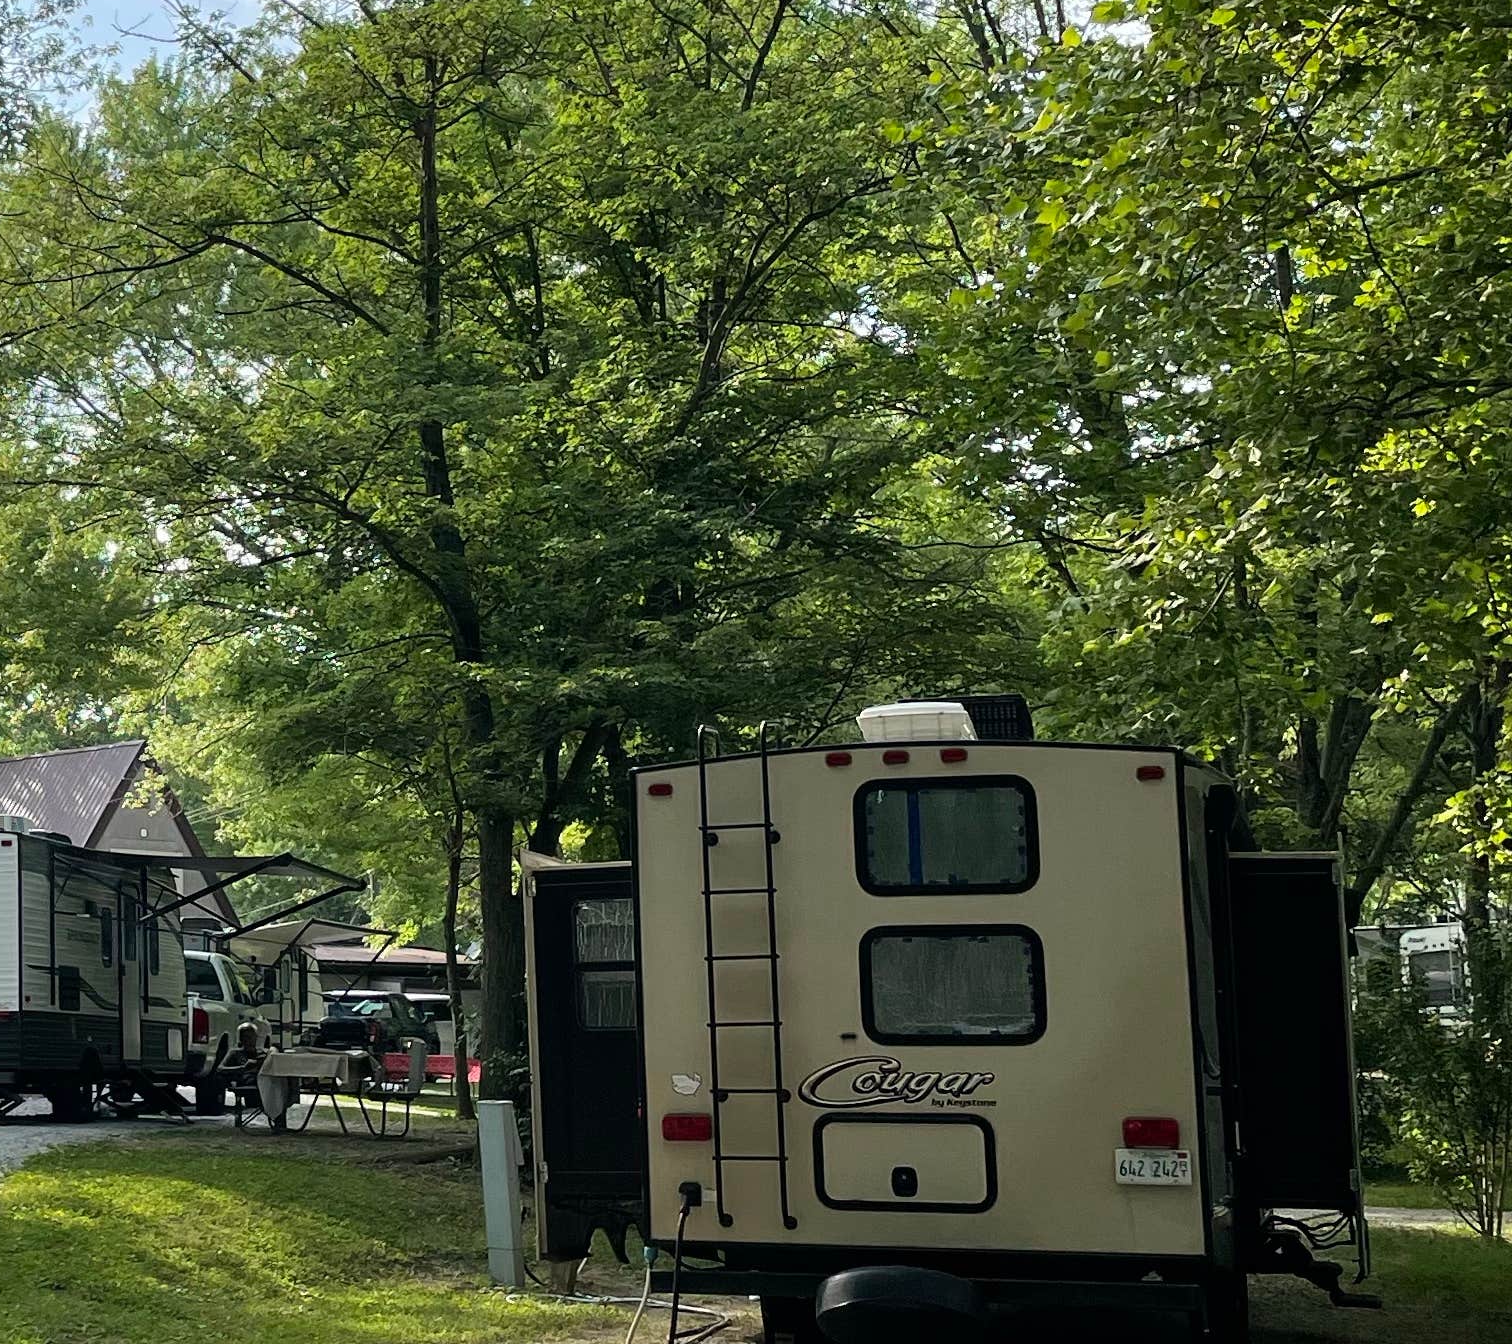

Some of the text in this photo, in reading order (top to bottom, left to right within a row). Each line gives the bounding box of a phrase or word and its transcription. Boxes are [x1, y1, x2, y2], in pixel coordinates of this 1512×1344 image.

[798, 1055, 995, 1108] Cougar
[931, 1098, 997, 1108] by Keystone
[1119, 1159, 1179, 1177] 642 242
